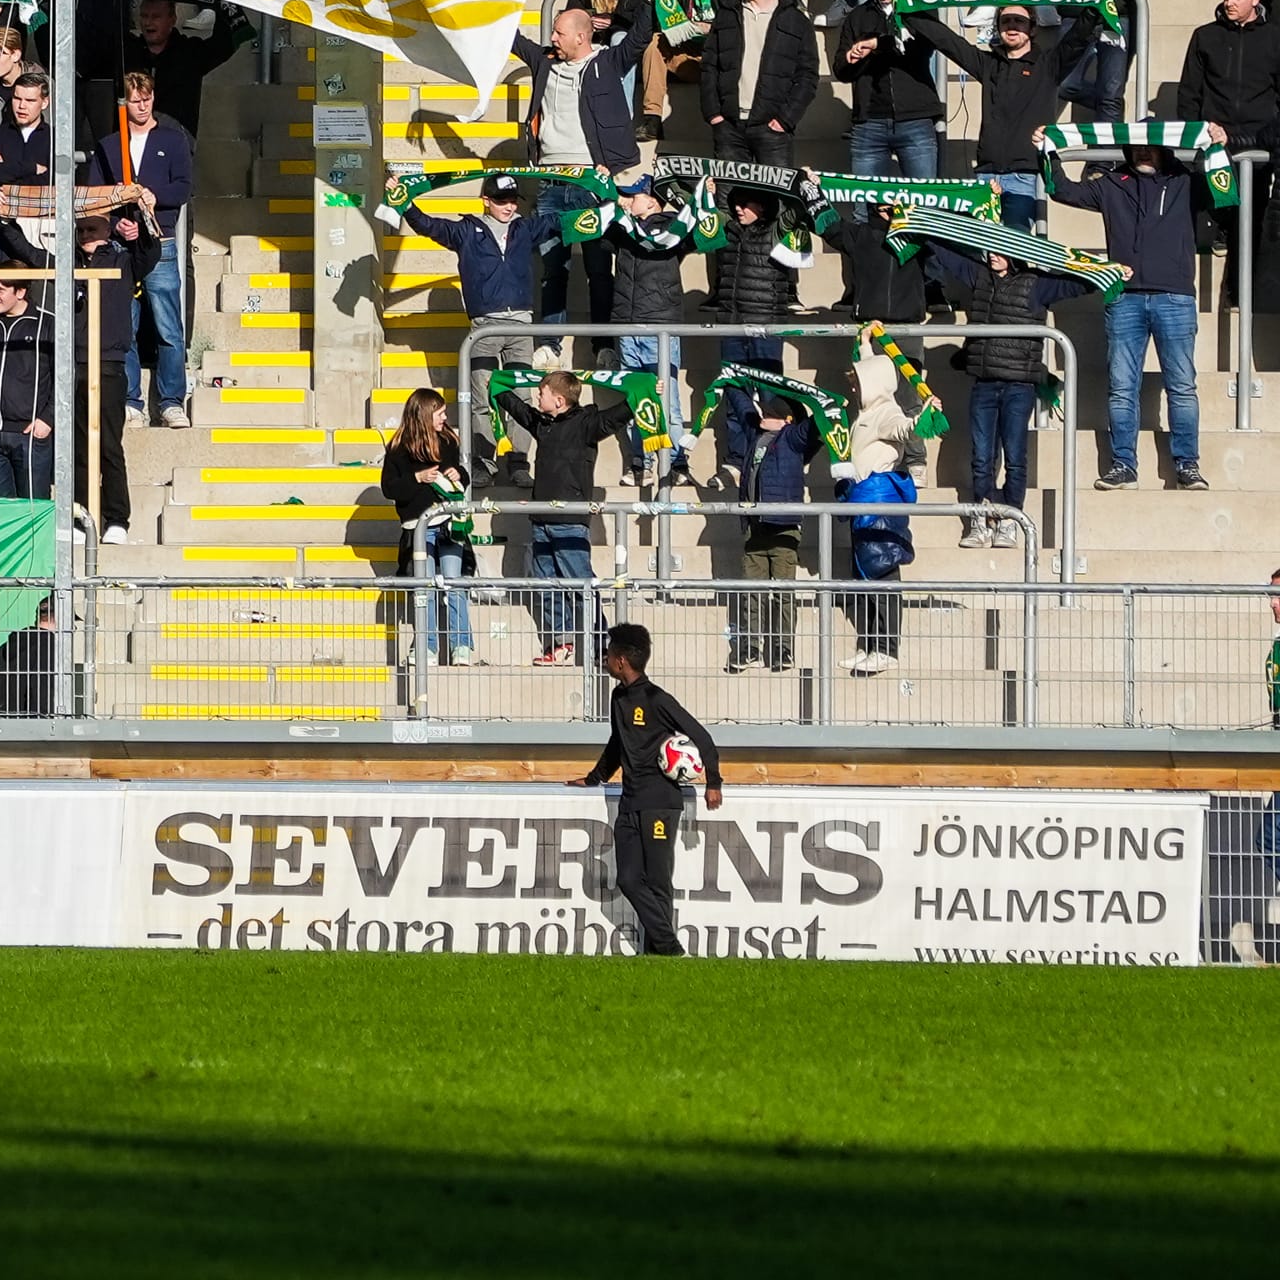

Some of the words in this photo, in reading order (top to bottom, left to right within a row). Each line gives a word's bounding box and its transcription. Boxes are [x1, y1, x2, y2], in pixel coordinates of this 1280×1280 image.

[708, 162, 795, 190] MACHINE
[152, 811, 884, 906] SEVERNS
[913, 814, 1185, 861] JÖNKÖPING
[914, 886, 1168, 925] HALMSTAD
[196, 902, 291, 952] det
[307, 907, 455, 953] stora
[475, 908, 827, 961] möbehuset
